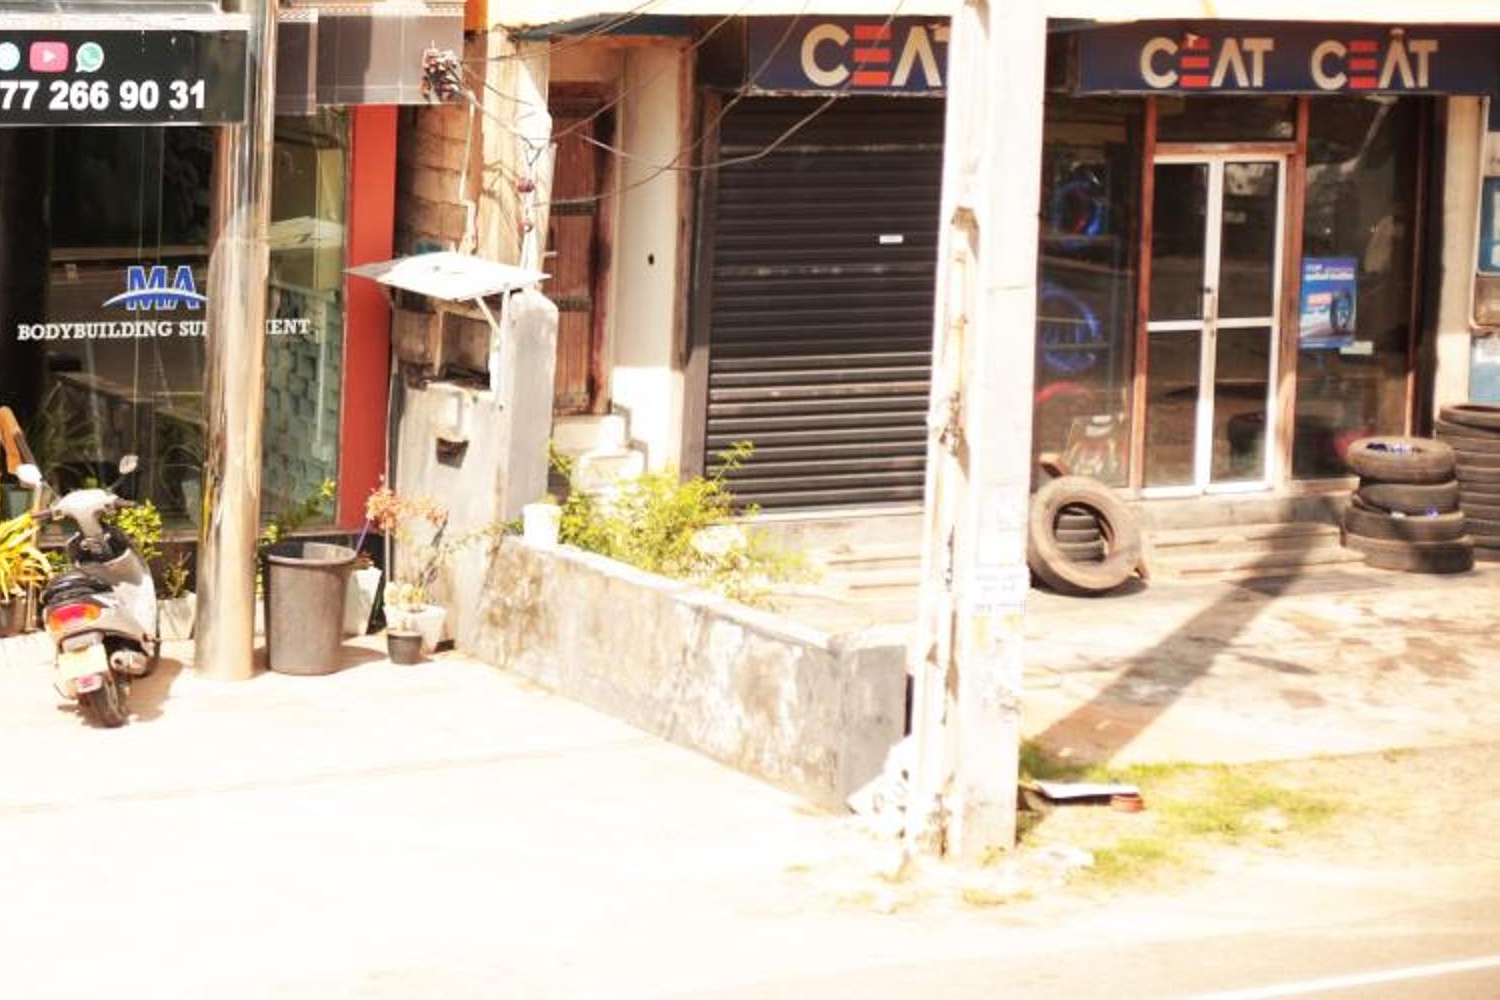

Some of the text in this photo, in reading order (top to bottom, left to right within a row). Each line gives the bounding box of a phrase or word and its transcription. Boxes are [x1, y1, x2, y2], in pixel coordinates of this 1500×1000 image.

[1140, 36, 1438, 90] CEAT CEAT
[48, 79, 110, 111] 266
[119, 79, 160, 111] 90
[168, 79, 206, 111] 31
[17, 318, 311, 341] BODYBUILDING SUENT
